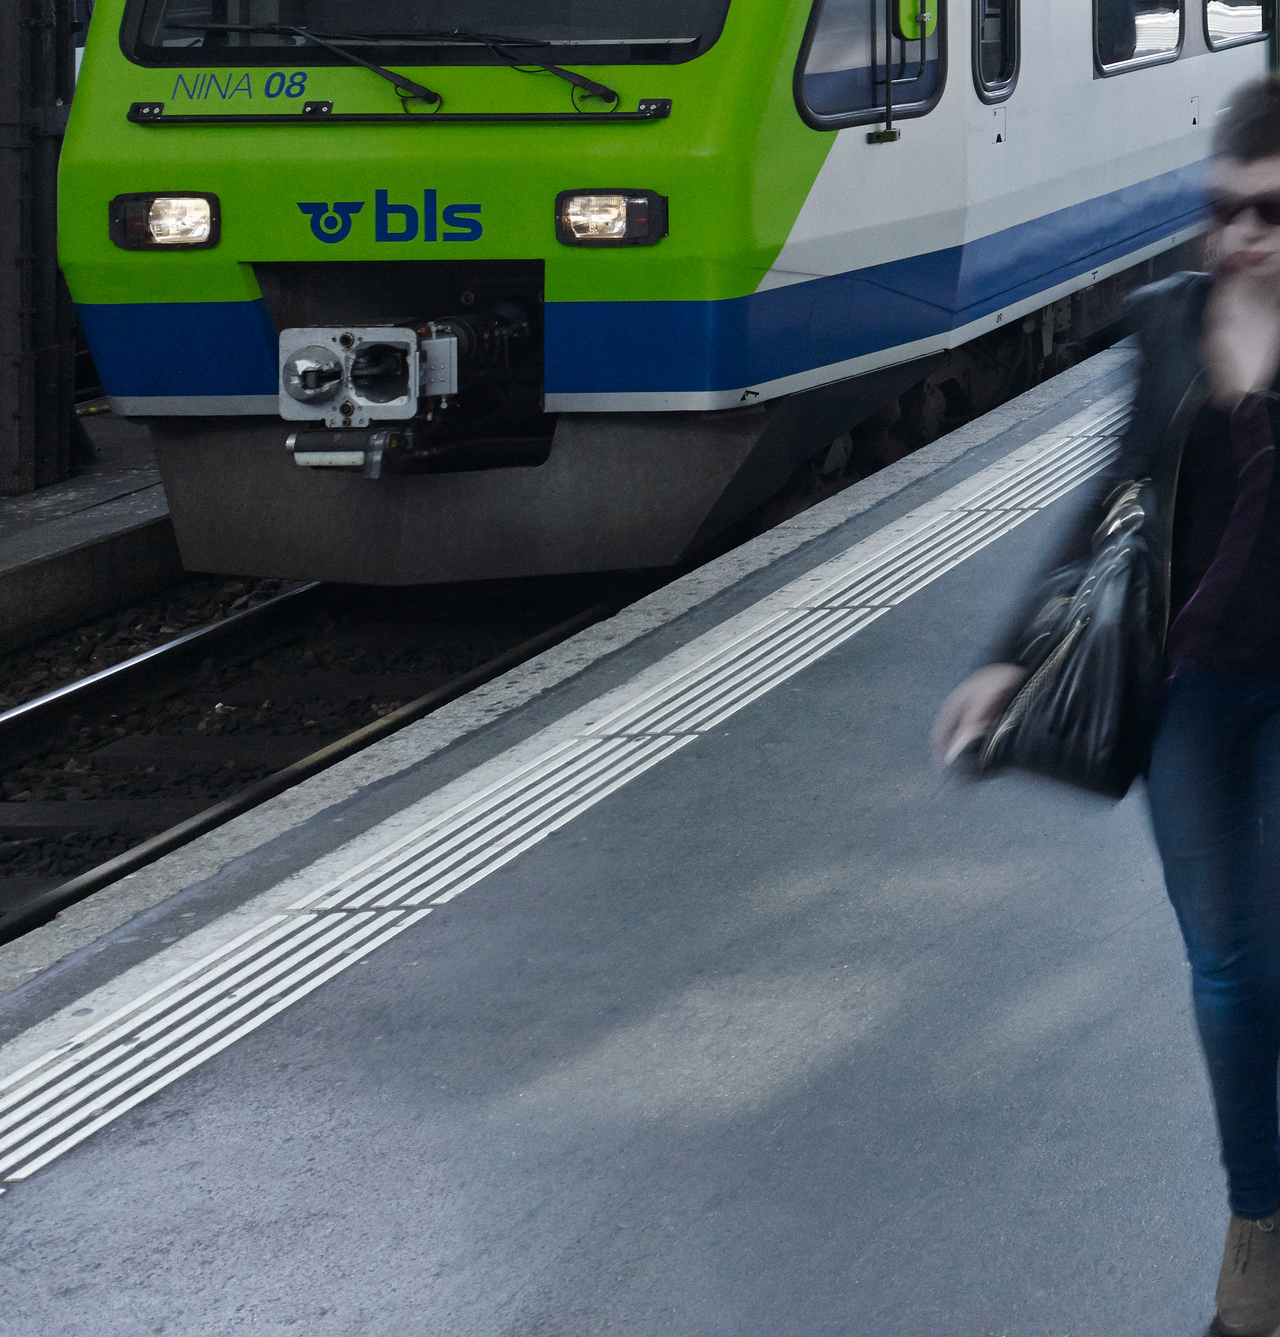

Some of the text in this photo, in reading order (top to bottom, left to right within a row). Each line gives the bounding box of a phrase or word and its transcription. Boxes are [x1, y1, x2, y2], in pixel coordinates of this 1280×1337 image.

[171, 71, 308, 100] NINA 08
[374, 188, 484, 243] bls
